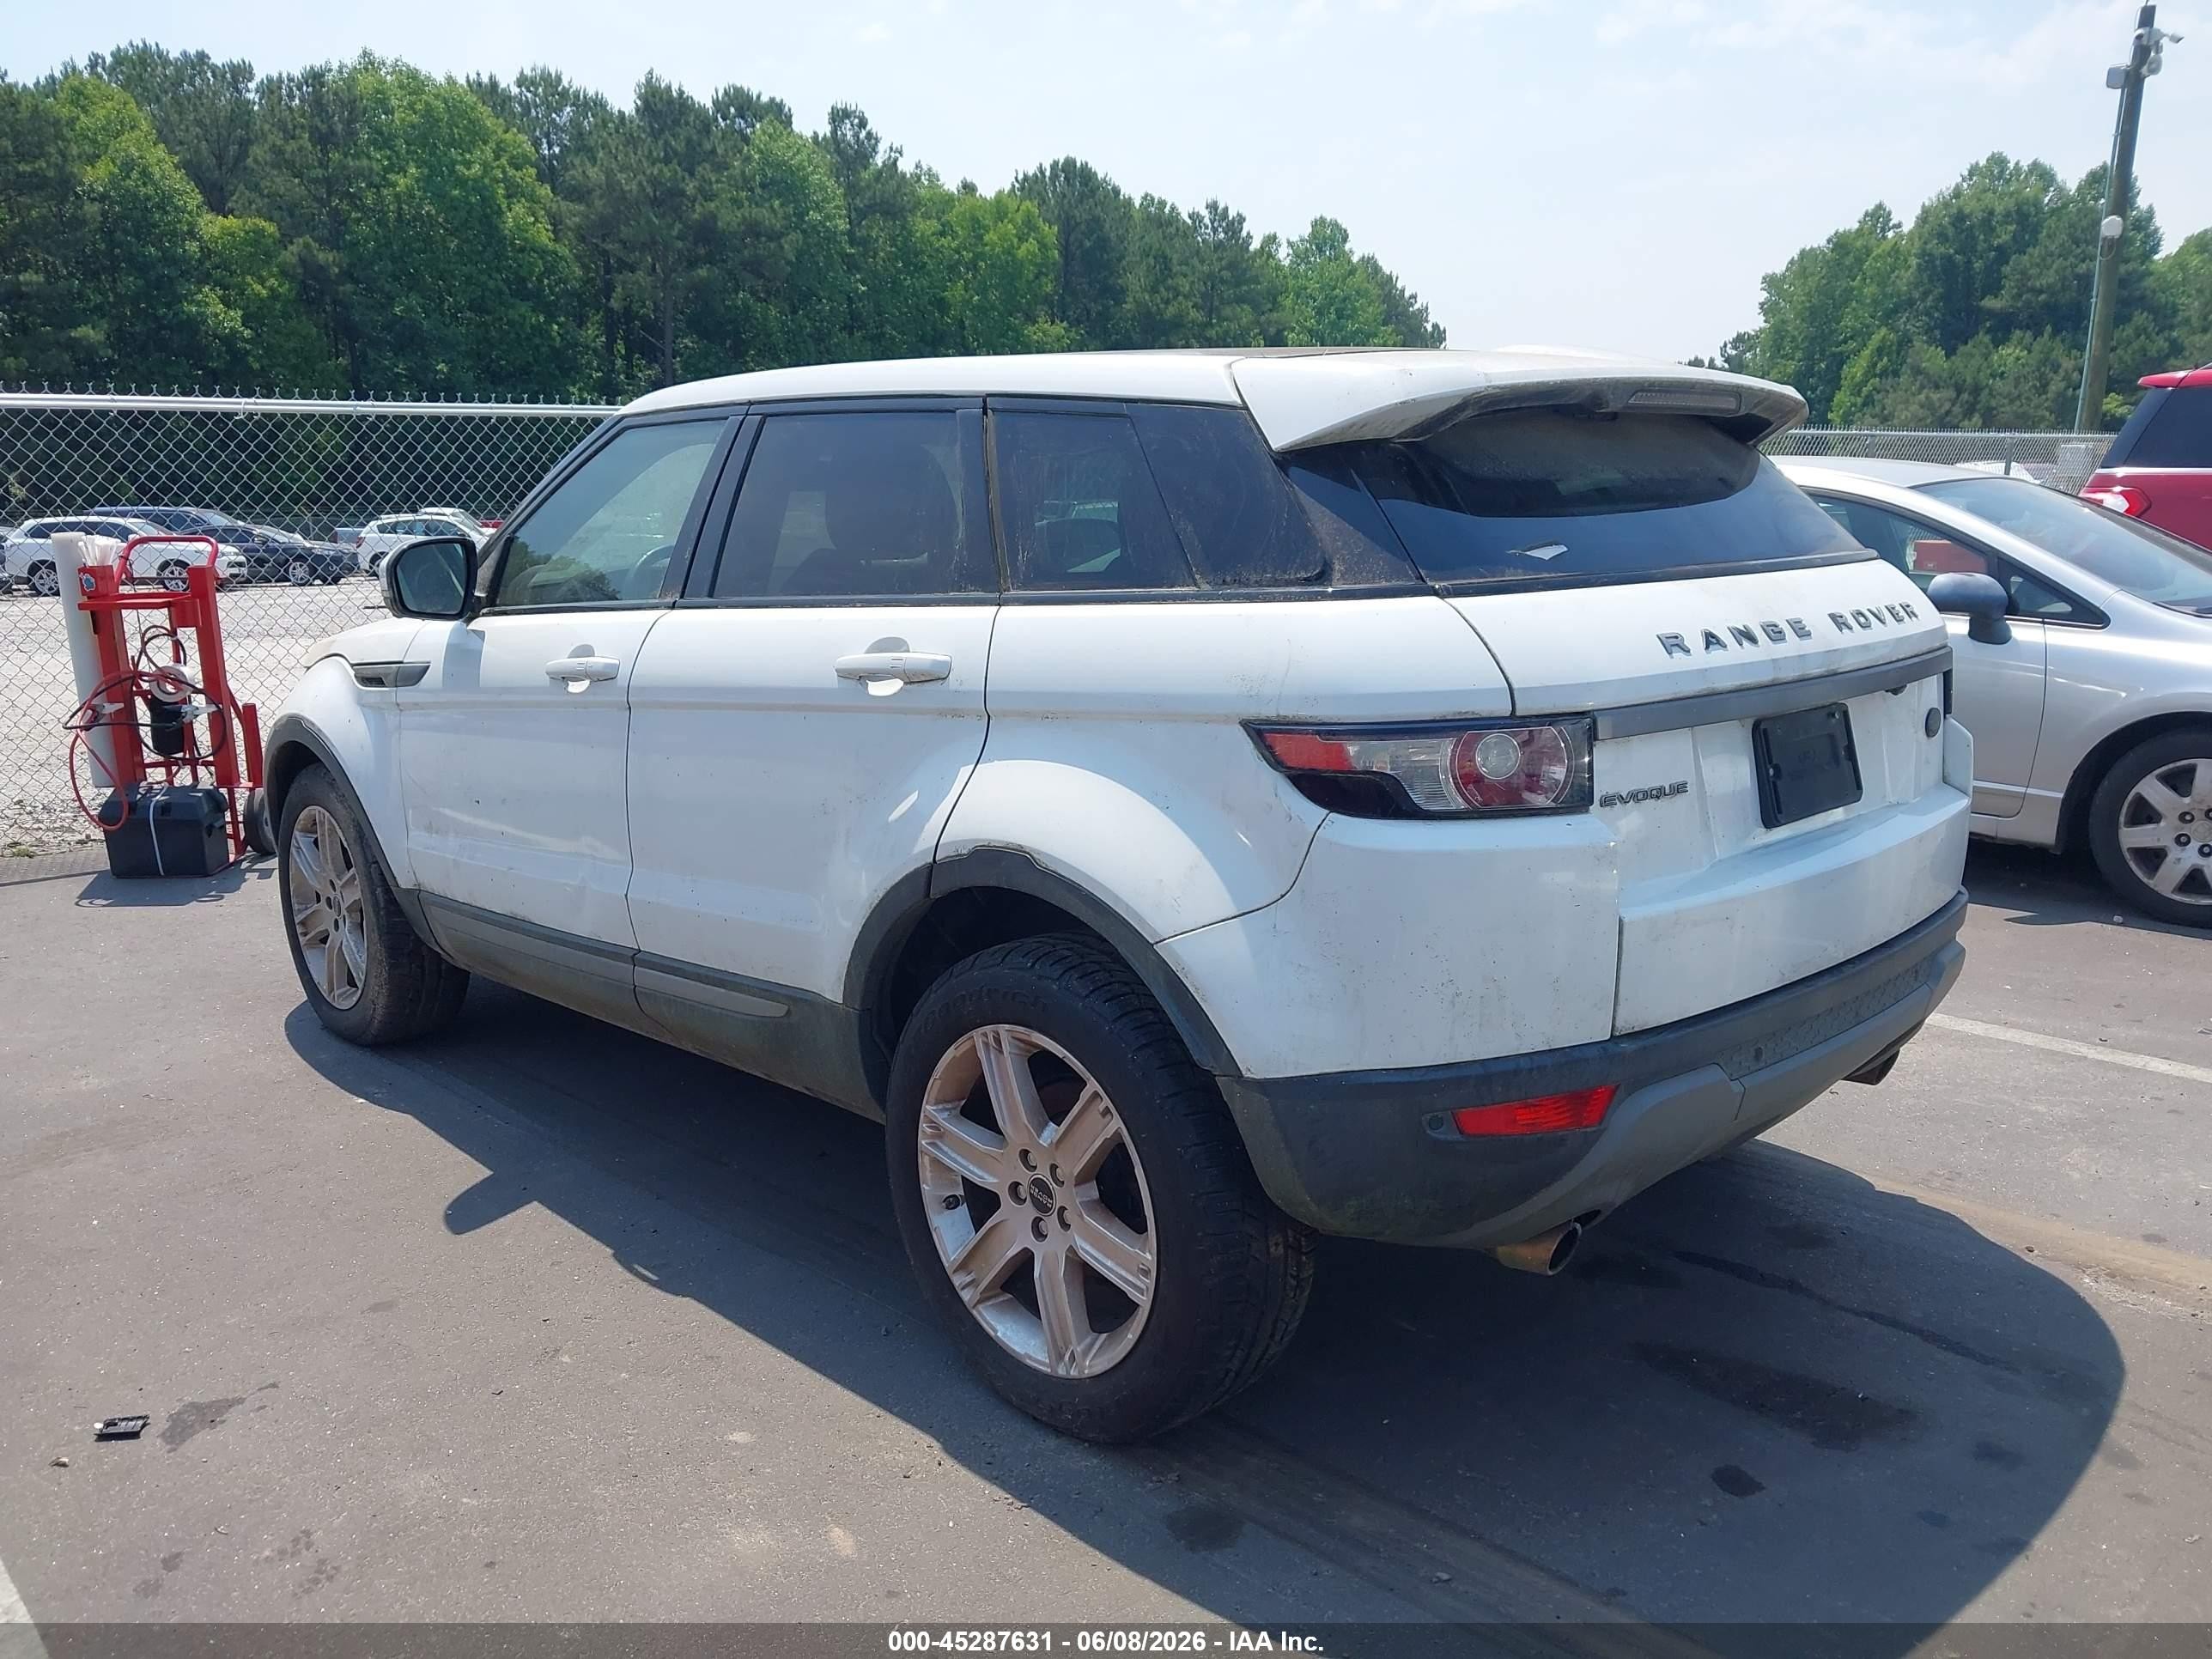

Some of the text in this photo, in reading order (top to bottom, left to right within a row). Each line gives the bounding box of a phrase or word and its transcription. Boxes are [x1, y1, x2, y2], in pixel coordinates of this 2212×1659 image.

[1656, 601, 1919, 657] RANGE ROVER
[1599, 780, 1689, 808] EVOQUE
